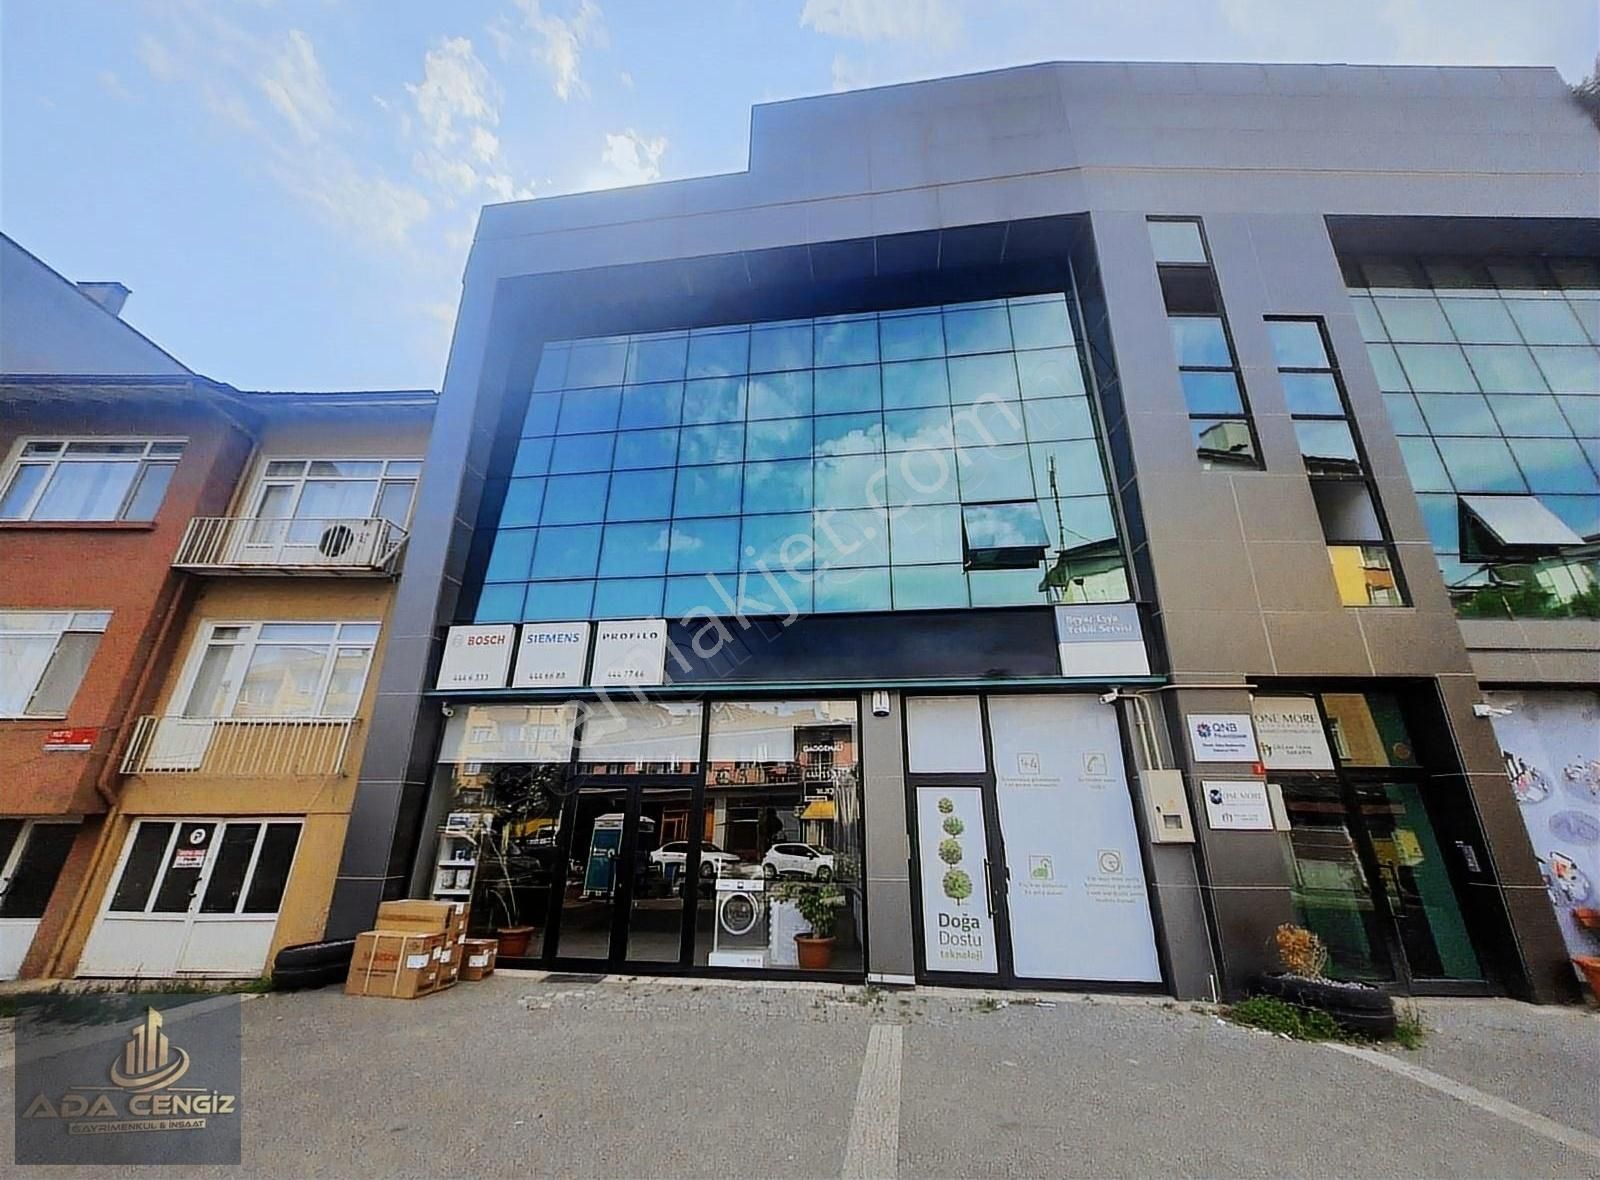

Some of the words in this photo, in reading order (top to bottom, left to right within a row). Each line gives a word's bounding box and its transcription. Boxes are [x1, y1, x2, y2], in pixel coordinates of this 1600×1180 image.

[467, 635, 506, 646] BOSCH
[526, 633, 580, 644] SIEMENS
[1212, 723, 1238, 732] QNB
[938, 912, 980, 932] Doğa
[939, 930, 982, 947] Dostu
